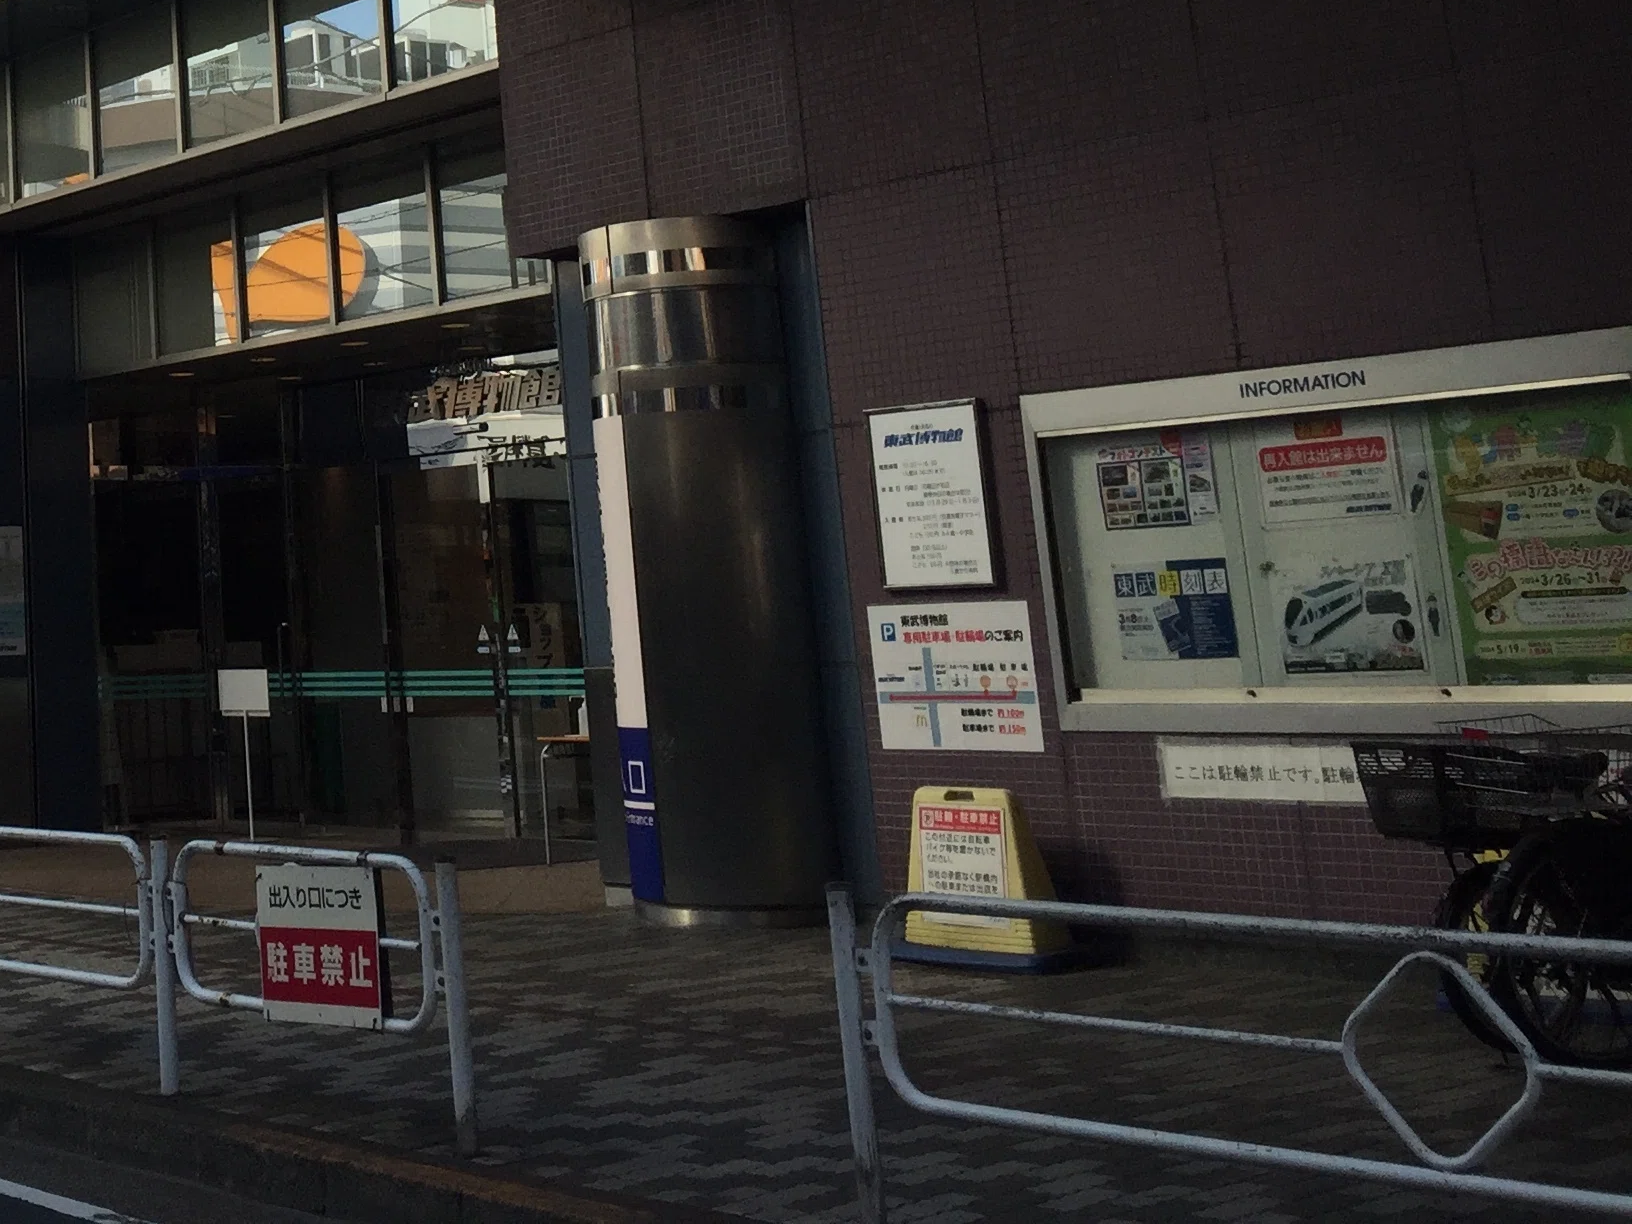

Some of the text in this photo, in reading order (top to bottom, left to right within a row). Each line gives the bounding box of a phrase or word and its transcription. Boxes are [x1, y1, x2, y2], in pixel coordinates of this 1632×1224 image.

[1240, 370, 1366, 398] INFORMATION
[1263, 444, 1384, 469] 再入館は出来ません
[1116, 568, 1226, 596] 東武時刻表
[883, 625, 894, 641] P
[900, 614, 949, 627] 東武博物館
[1174, 764, 1361, 784] ここは駐輪禁止です。駐輪
[268, 885, 362, 910] 出入り口につき
[266, 941, 373, 988] 駐車禁止
